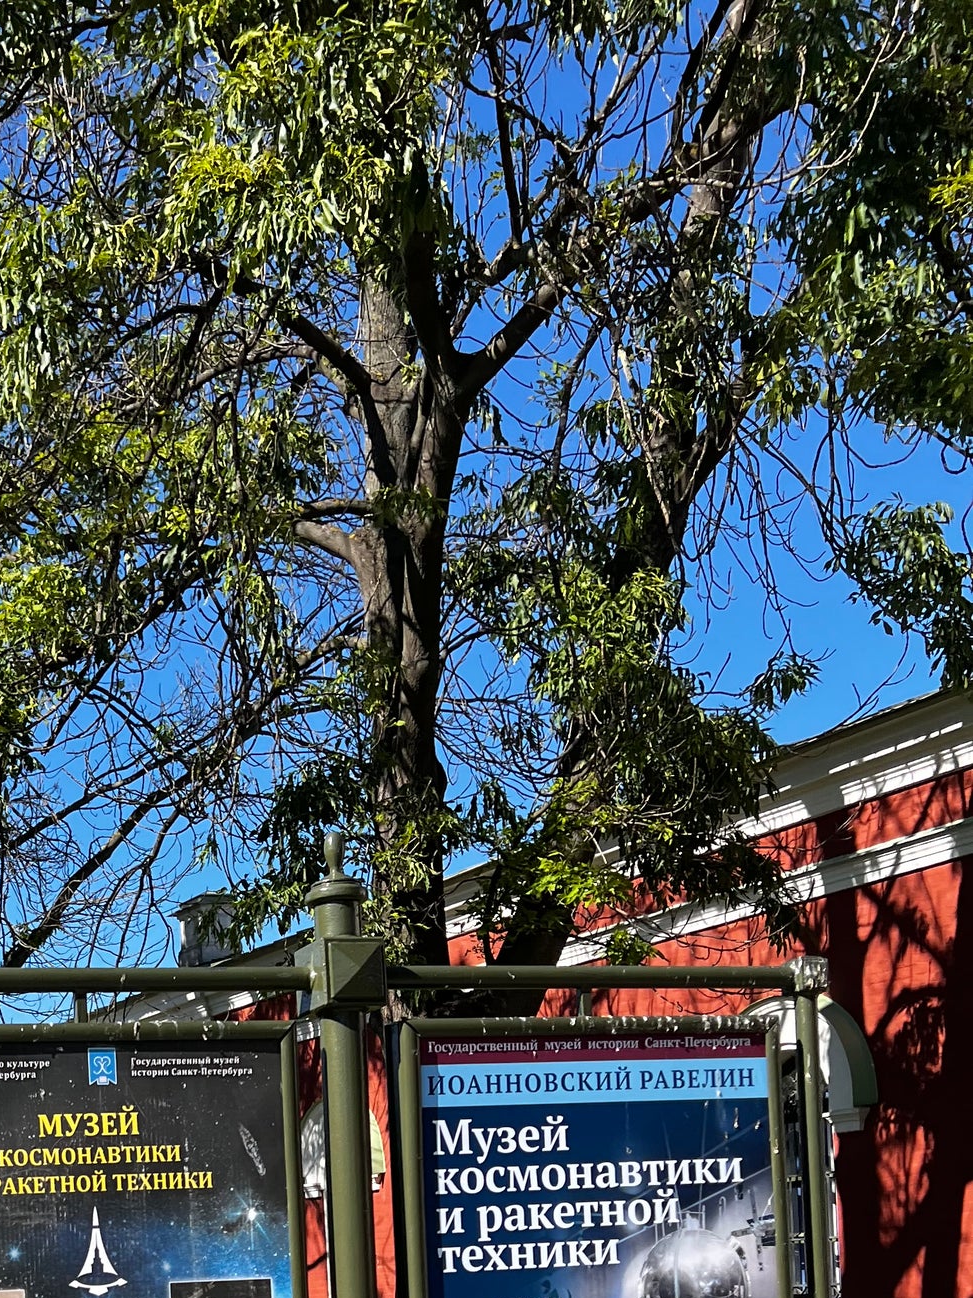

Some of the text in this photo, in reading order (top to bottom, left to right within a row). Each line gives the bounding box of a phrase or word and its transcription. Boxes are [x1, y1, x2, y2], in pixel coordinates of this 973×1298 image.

[428, 1036, 751, 1055] Государственный музей истории Санкт-Петербурга
[7, 1060, 50, 1072] культуре
[131, 1056, 240, 1068] Государственный музей
[131, 1067, 253, 1078] истории Санкт-Петербурга
[427, 1066, 755, 1096] ИОАННОВСКИЙ РАВЕЛИН
[37, 1105, 140, 1138] МУЗЕЙ
[432, 1115, 570, 1164] Музей
[115, 1170, 213, 1193] ТЕХНИКИ
[434, 1157, 744, 1196] космонавтики
[436, 1188, 680, 1242] и ракетной
[438, 1238, 621, 1274] техники
